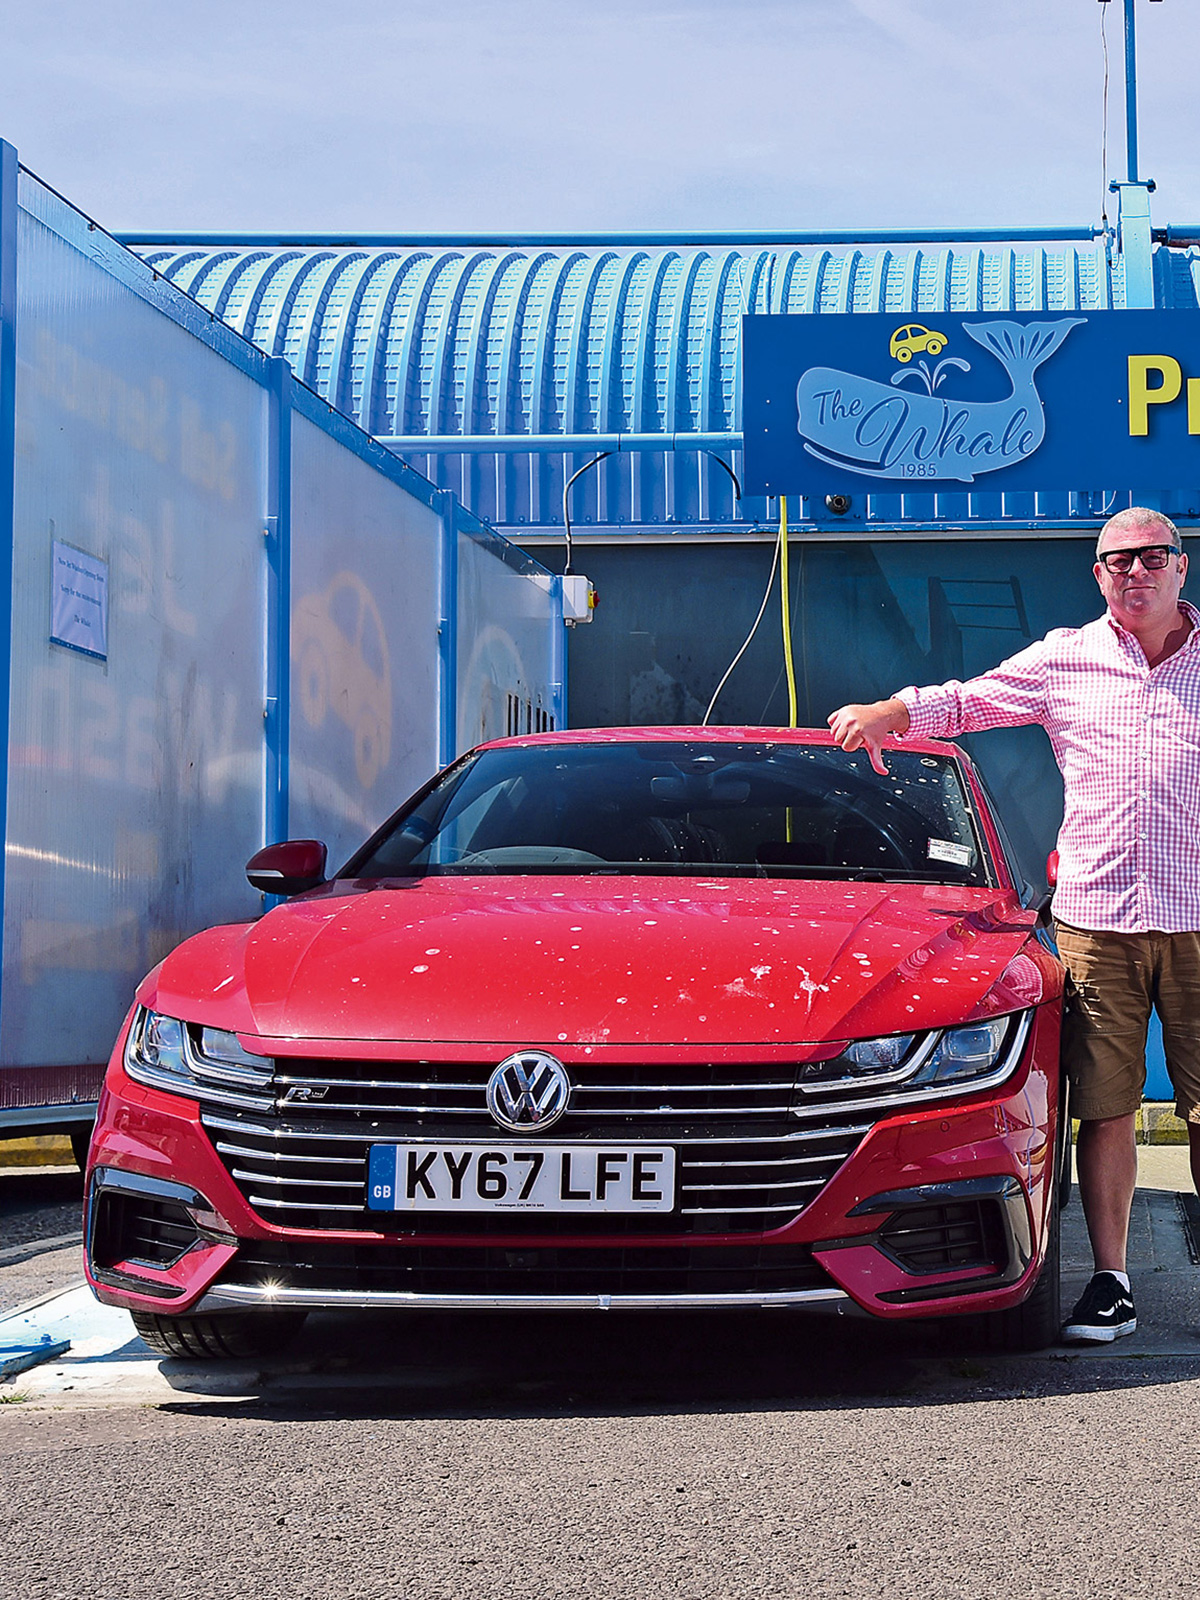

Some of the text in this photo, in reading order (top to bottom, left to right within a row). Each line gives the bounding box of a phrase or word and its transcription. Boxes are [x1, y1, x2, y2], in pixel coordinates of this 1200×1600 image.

[811, 388, 1035, 470] The Whale
[900, 463, 937, 478] 1985
[373, 1184, 392, 1199] GB
[406, 1150, 664, 1201] KY67 LFE
